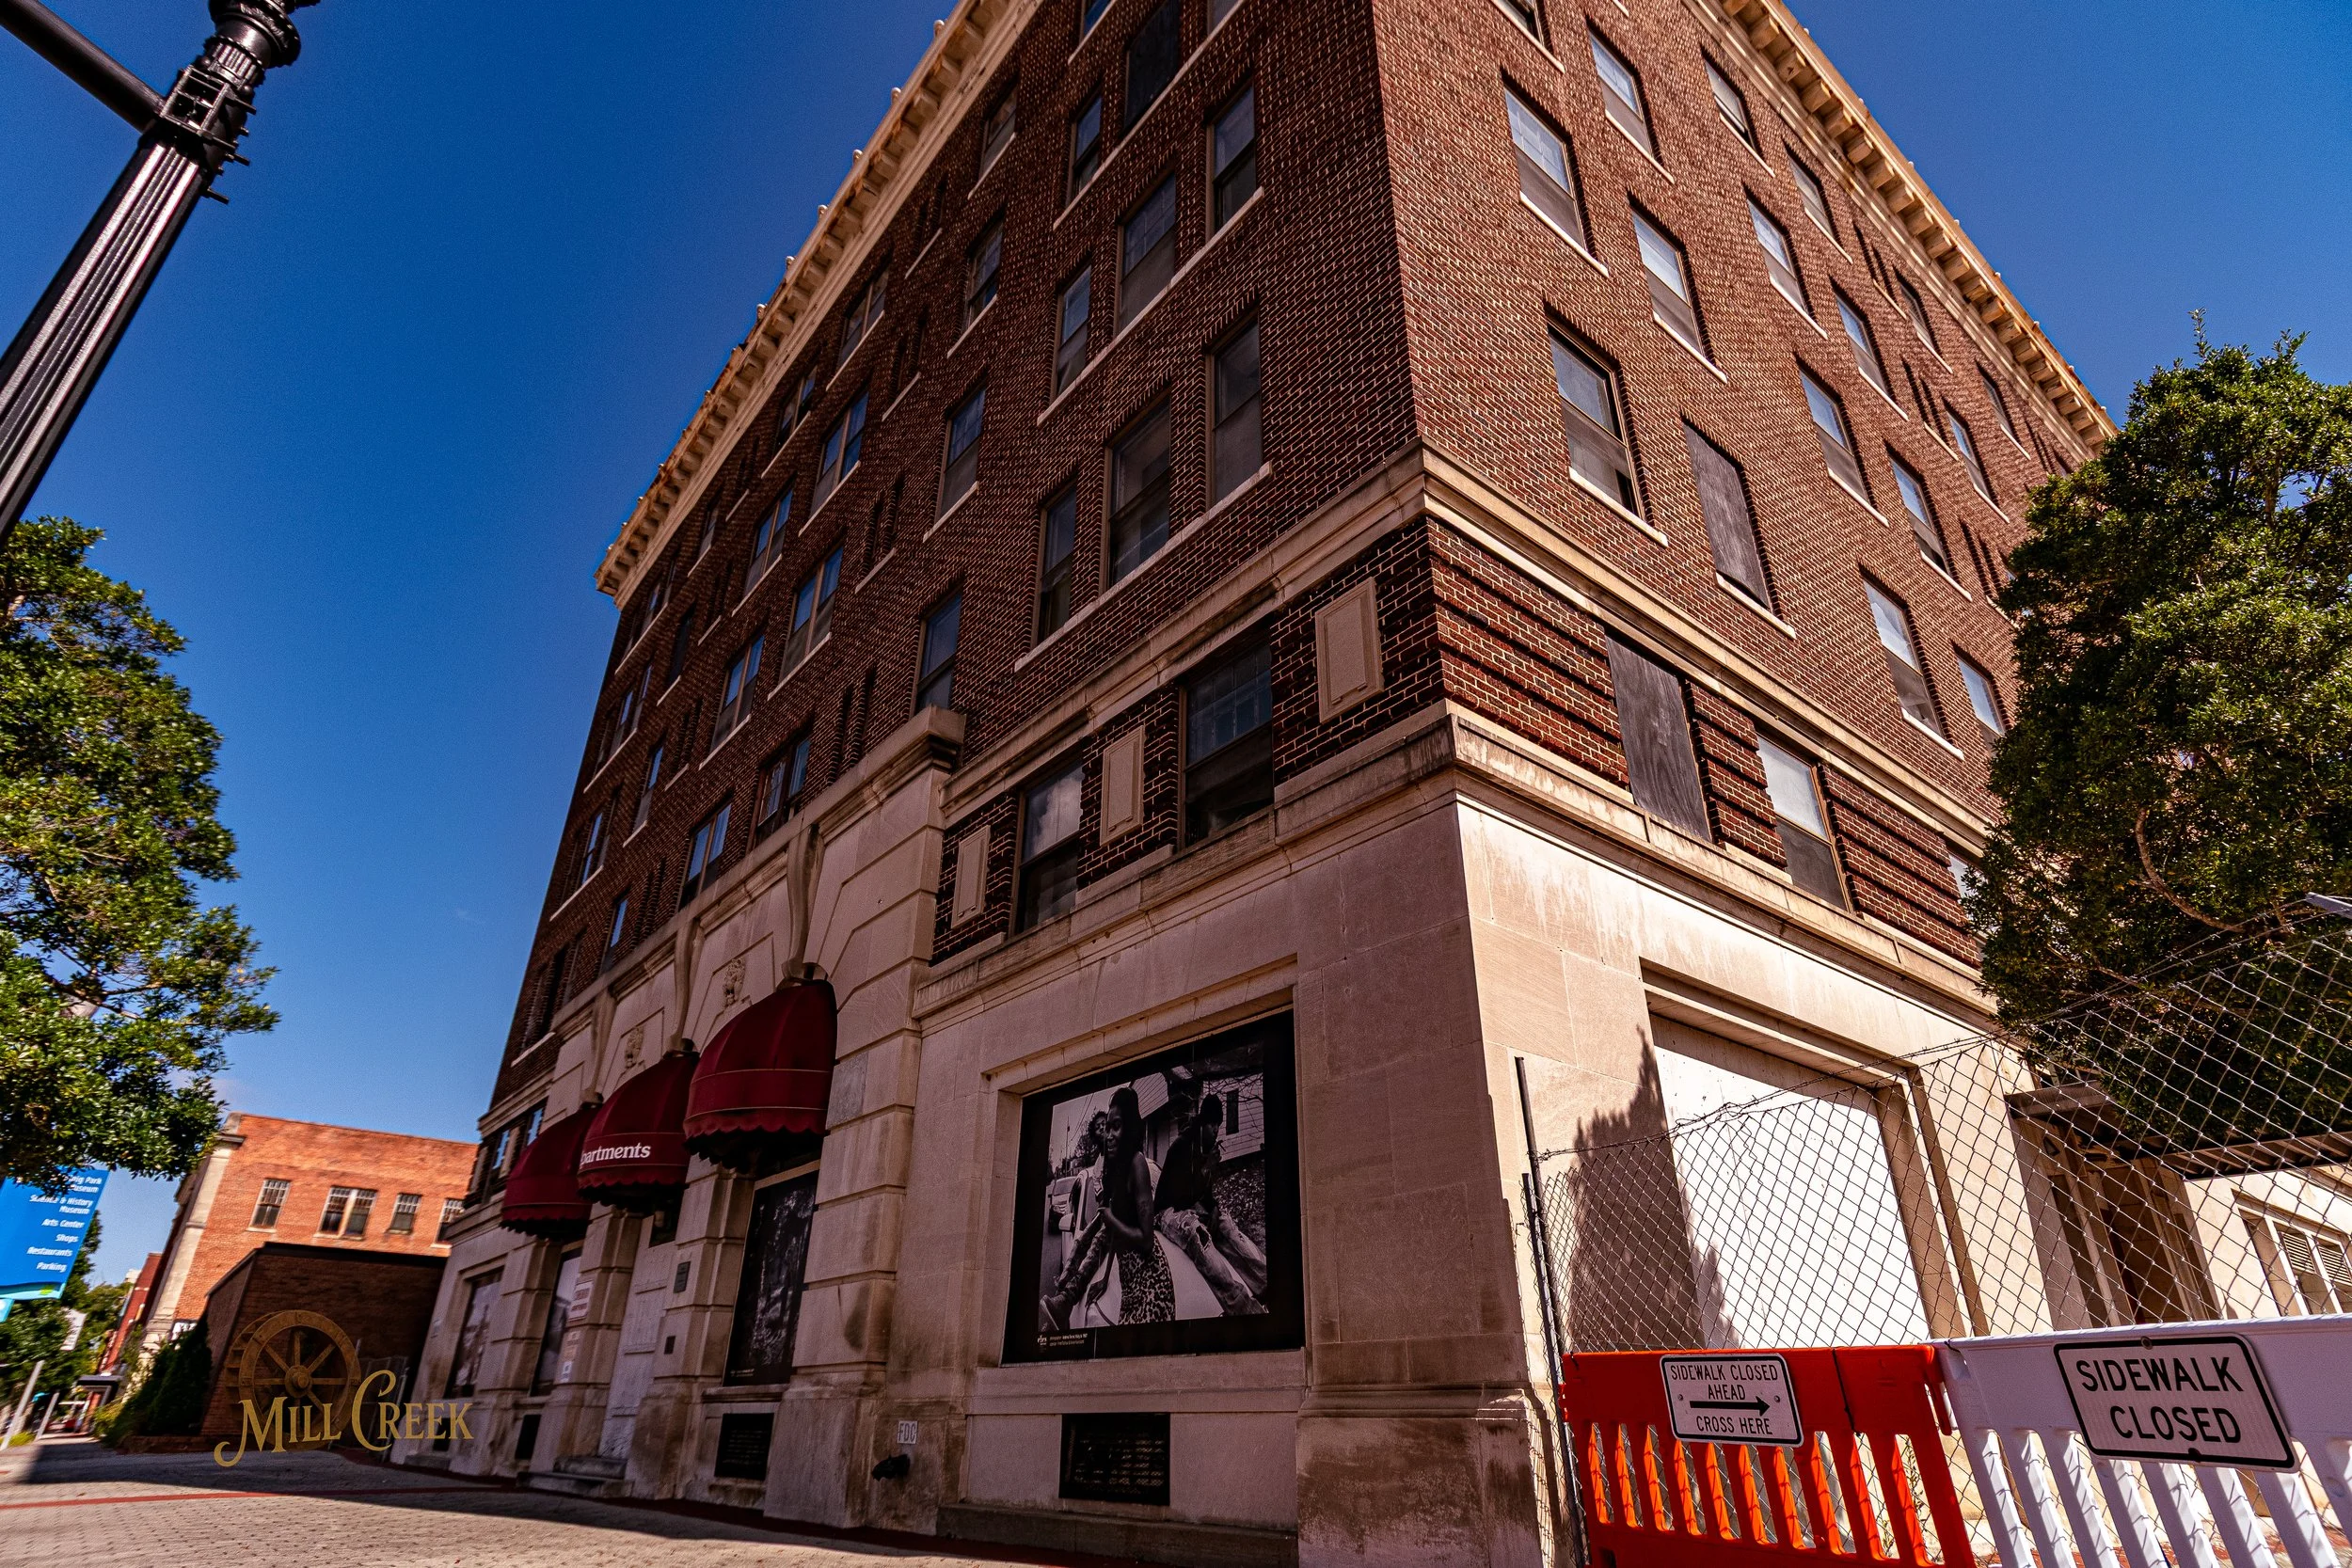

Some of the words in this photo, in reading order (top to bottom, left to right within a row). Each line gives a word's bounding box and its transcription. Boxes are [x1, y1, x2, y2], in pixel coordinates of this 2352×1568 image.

[579, 1142, 652, 1170] partments
[85, 1176, 103, 1185] Park
[59, 1205, 90, 1214] Museum
[67, 1197, 93, 1208] History
[41, 1218, 59, 1227] Arts
[60, 1220, 86, 1228] Center
[55, 1234, 79, 1243] Shops
[26, 1246, 73, 1257] Restaurants
[36, 1261, 68, 1273] Parking
[1670, 1364, 1725, 1381] SIDEWALK
[1730, 1364, 1778, 1381] CLOSED
[2075, 1357, 2244, 1392] SIDEWALK
[1708, 1384, 1746, 1401] AHEAD
[1696, 1416, 1735, 1433] CROSS
[1739, 1418, 1773, 1434] HERE
[2110, 1405, 2241, 1444] CLOSED
[898, 1422, 916, 1442] FDC
